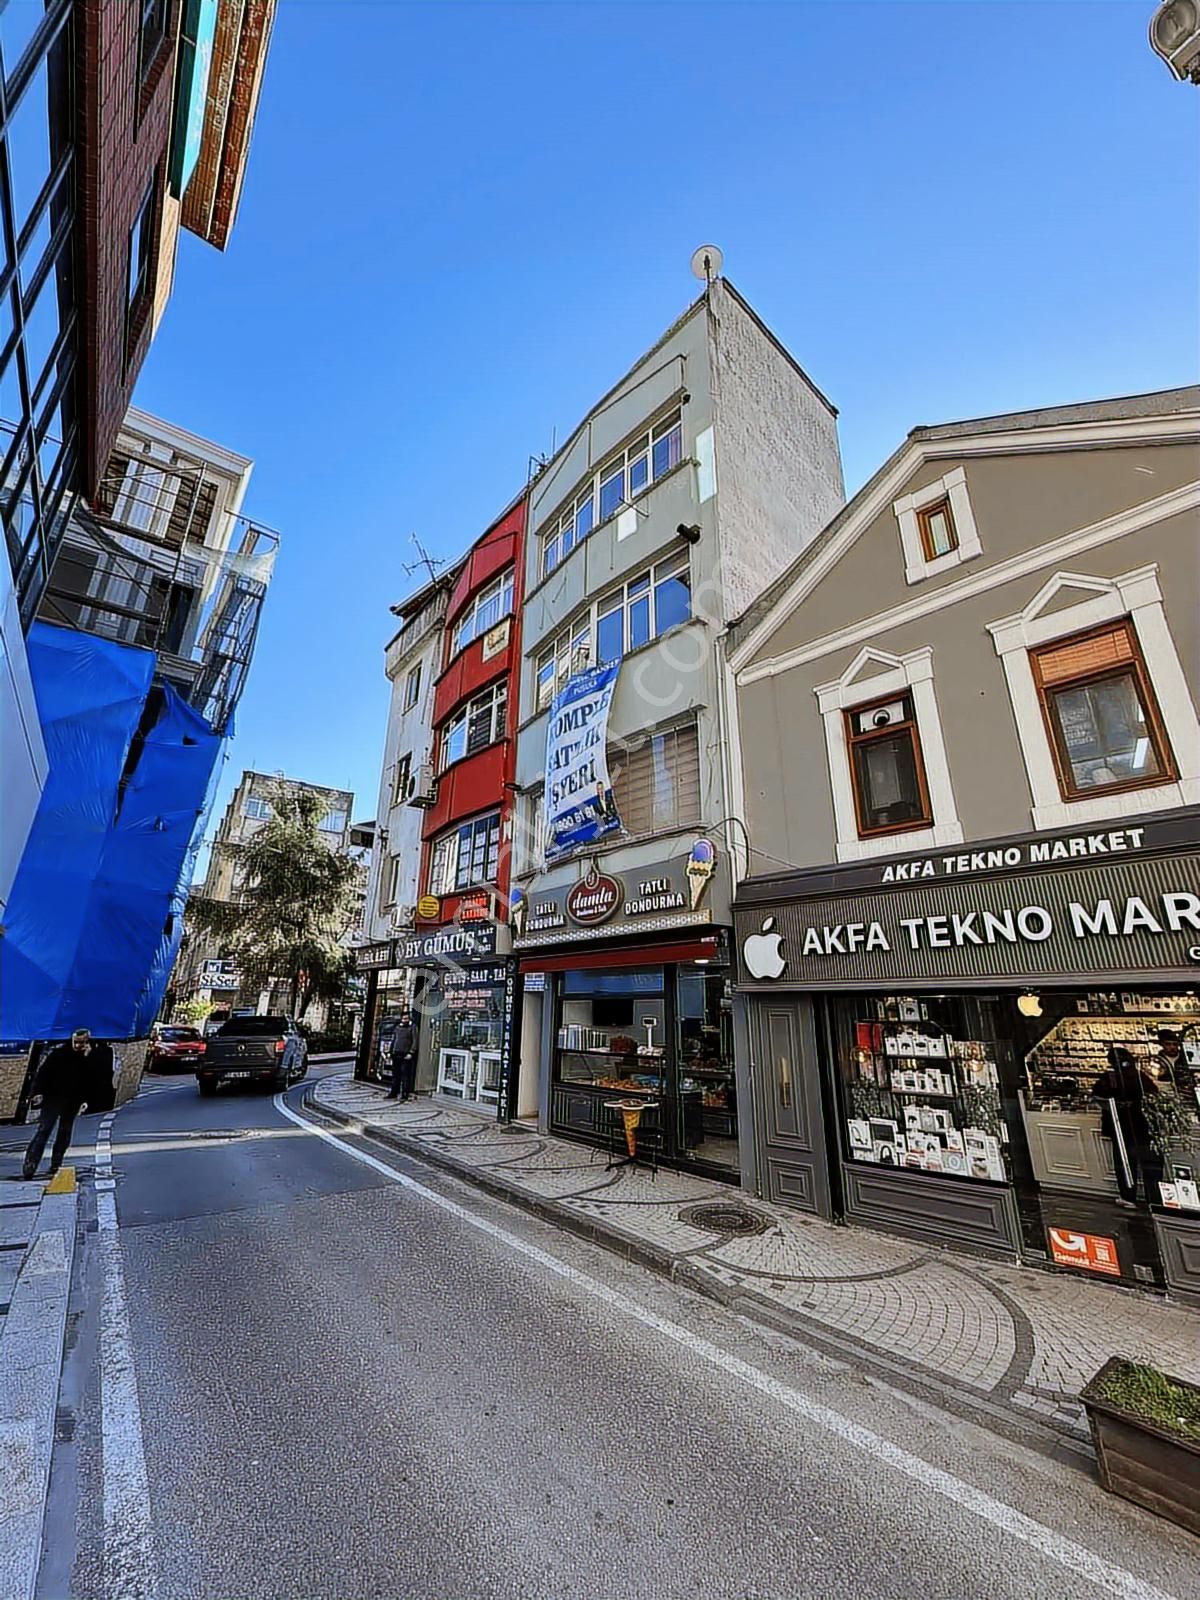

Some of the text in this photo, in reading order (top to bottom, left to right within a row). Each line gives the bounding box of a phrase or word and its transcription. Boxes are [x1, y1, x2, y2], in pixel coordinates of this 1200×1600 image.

[881, 828, 1145, 883] AKFA TEKNO MARKET
[572, 886, 614, 909] damla
[639, 879, 667, 895] TATLI
[535, 902, 555, 915] TATLI
[625, 893, 683, 914] DONDURMA
[803, 922, 890, 956] AKFA
[900, 905, 1053, 949] TEKNO
[405, 939, 422, 958] BY
[424, 928, 475, 955] GÜMÜŞ
